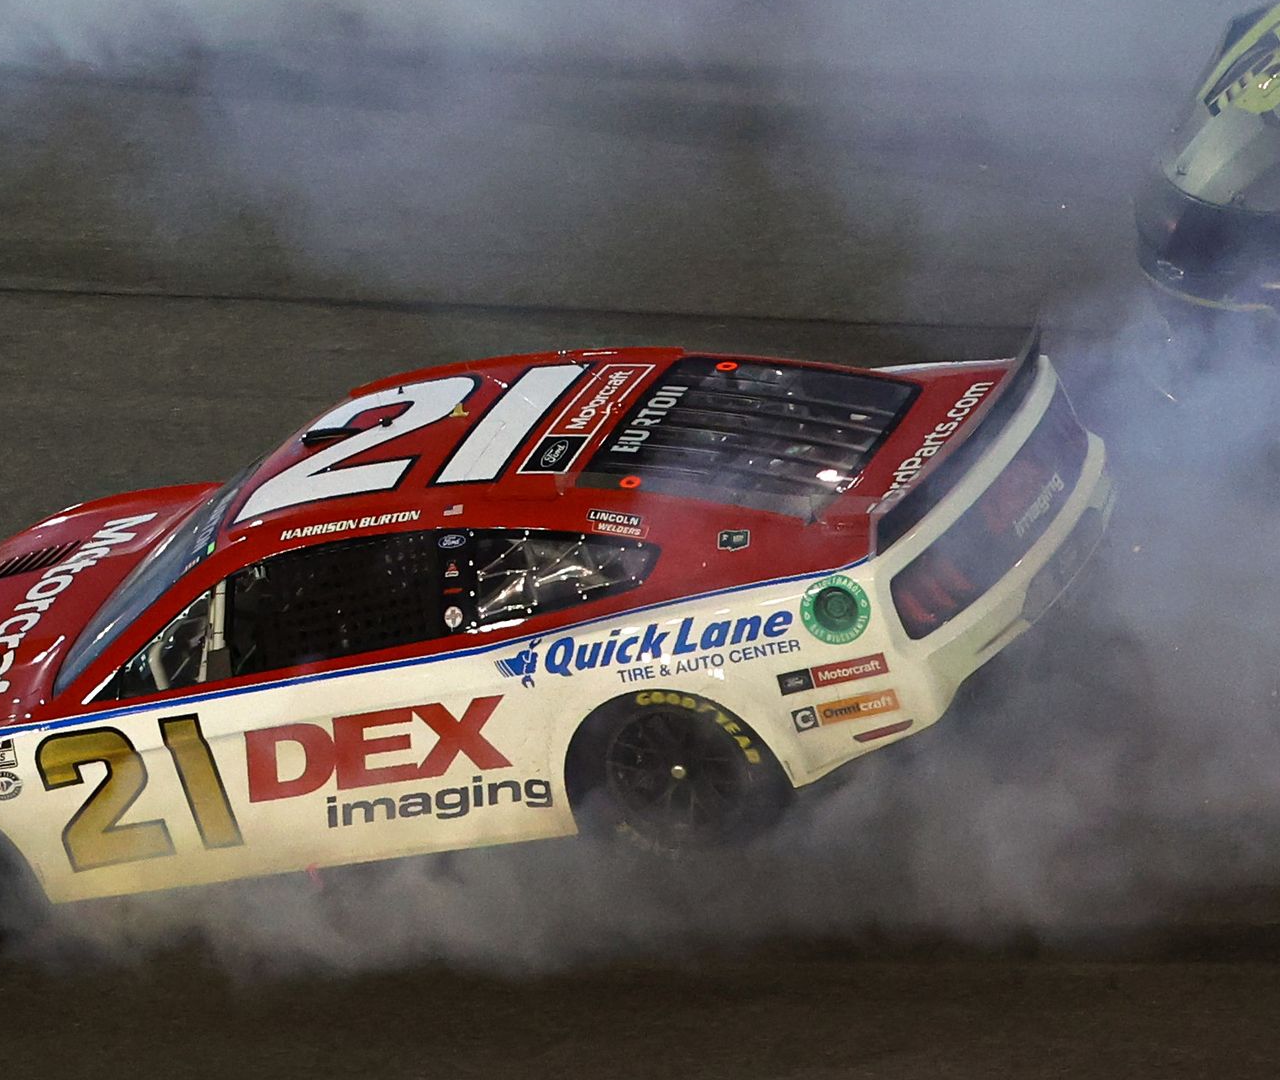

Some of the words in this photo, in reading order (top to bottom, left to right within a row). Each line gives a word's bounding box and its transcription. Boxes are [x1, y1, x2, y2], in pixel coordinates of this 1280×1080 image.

[566, 369, 635, 430] Motorcraft
[231, 363, 596, 526] 21
[544, 441, 567, 465] Ford
[867, 381, 995, 514] ordParts.com
[281, 519, 358, 540] HARRISON
[358, 510, 421, 528] BURTON
[589, 511, 639, 526] LINCOLN
[597, 523, 641, 535] WELDERS
[545, 623, 671, 676] Quick
[672, 611, 793, 655] Lane
[617, 665, 654, 683] TIRE
[660, 663, 671, 675] &
[676, 653, 725, 676] AUTO
[729, 639, 801, 663] CENTER
[819, 661, 881, 682] Motorcraft
[822, 694, 894, 719] Omnicraft
[244, 694, 512, 803] DEX
[35, 713, 244, 872] 21
[326, 775, 554, 828] imaging
